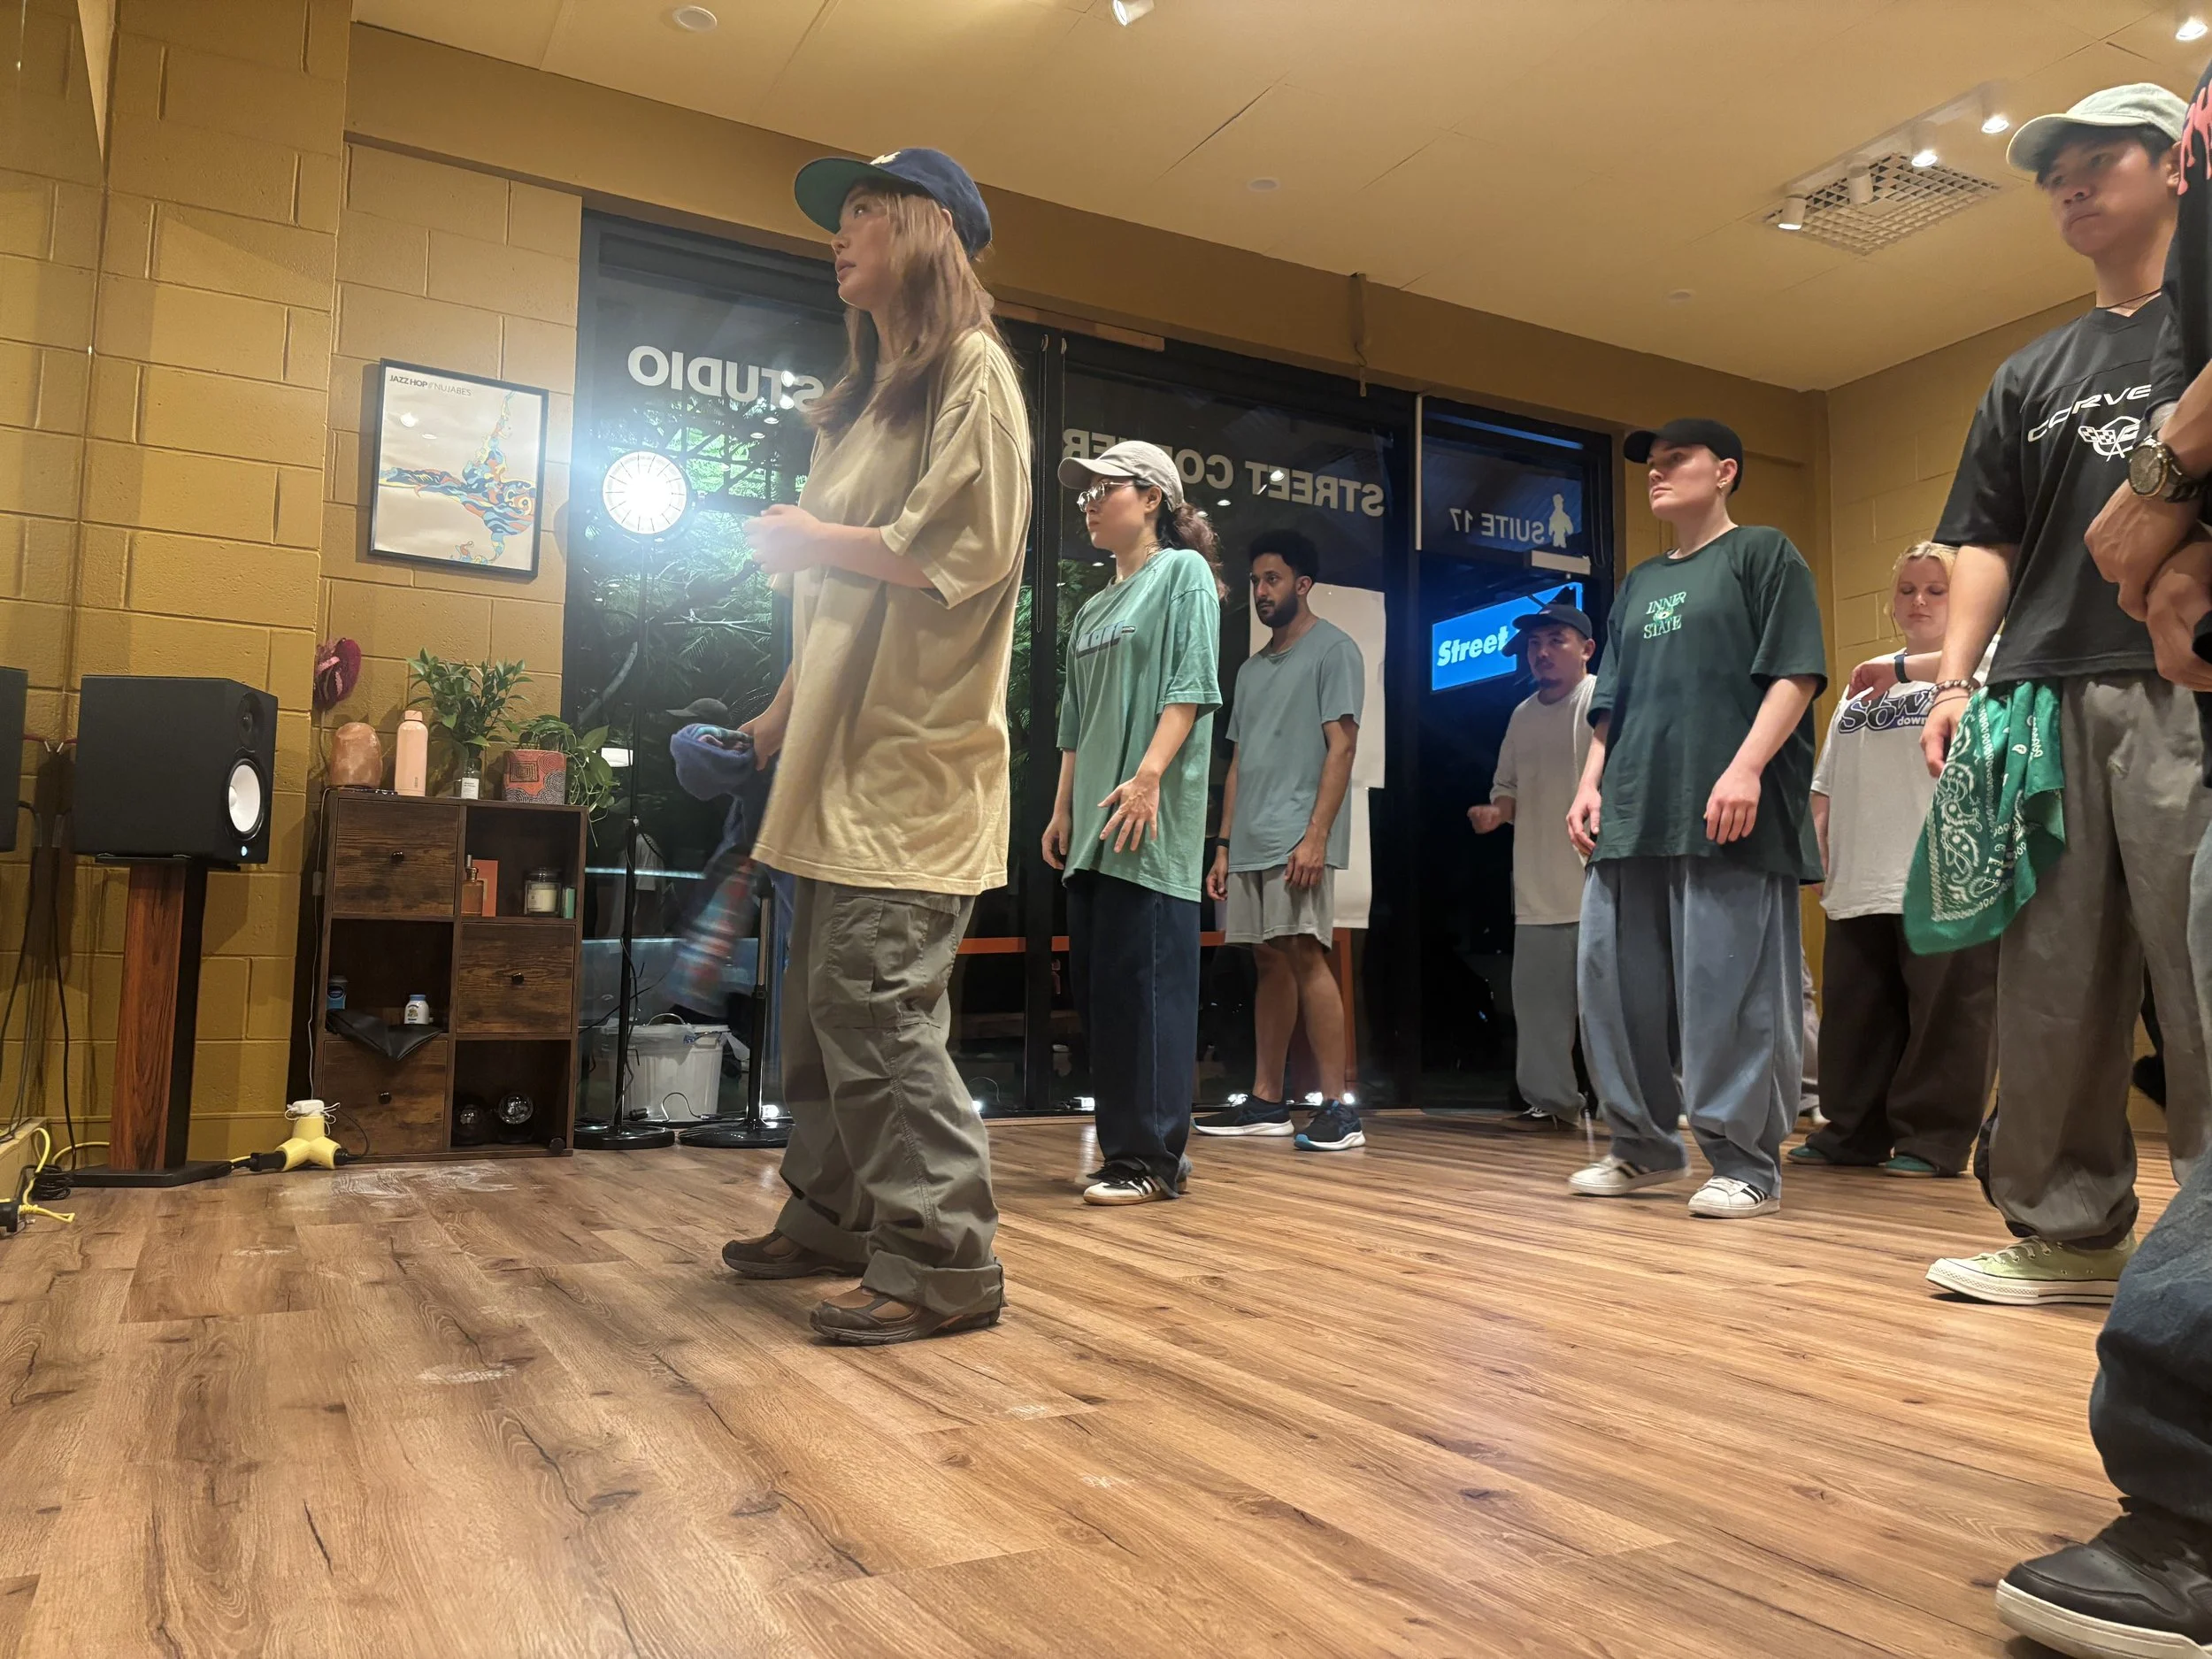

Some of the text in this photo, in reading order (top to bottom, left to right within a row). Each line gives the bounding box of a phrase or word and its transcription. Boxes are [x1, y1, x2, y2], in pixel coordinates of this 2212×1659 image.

[389, 375, 410, 385] JAZZ
[410, 379, 428, 388] HOP
[1646, 591, 1686, 614] INNER
[1643, 615, 1682, 639] STATE
[1437, 626, 1509, 667] Street
